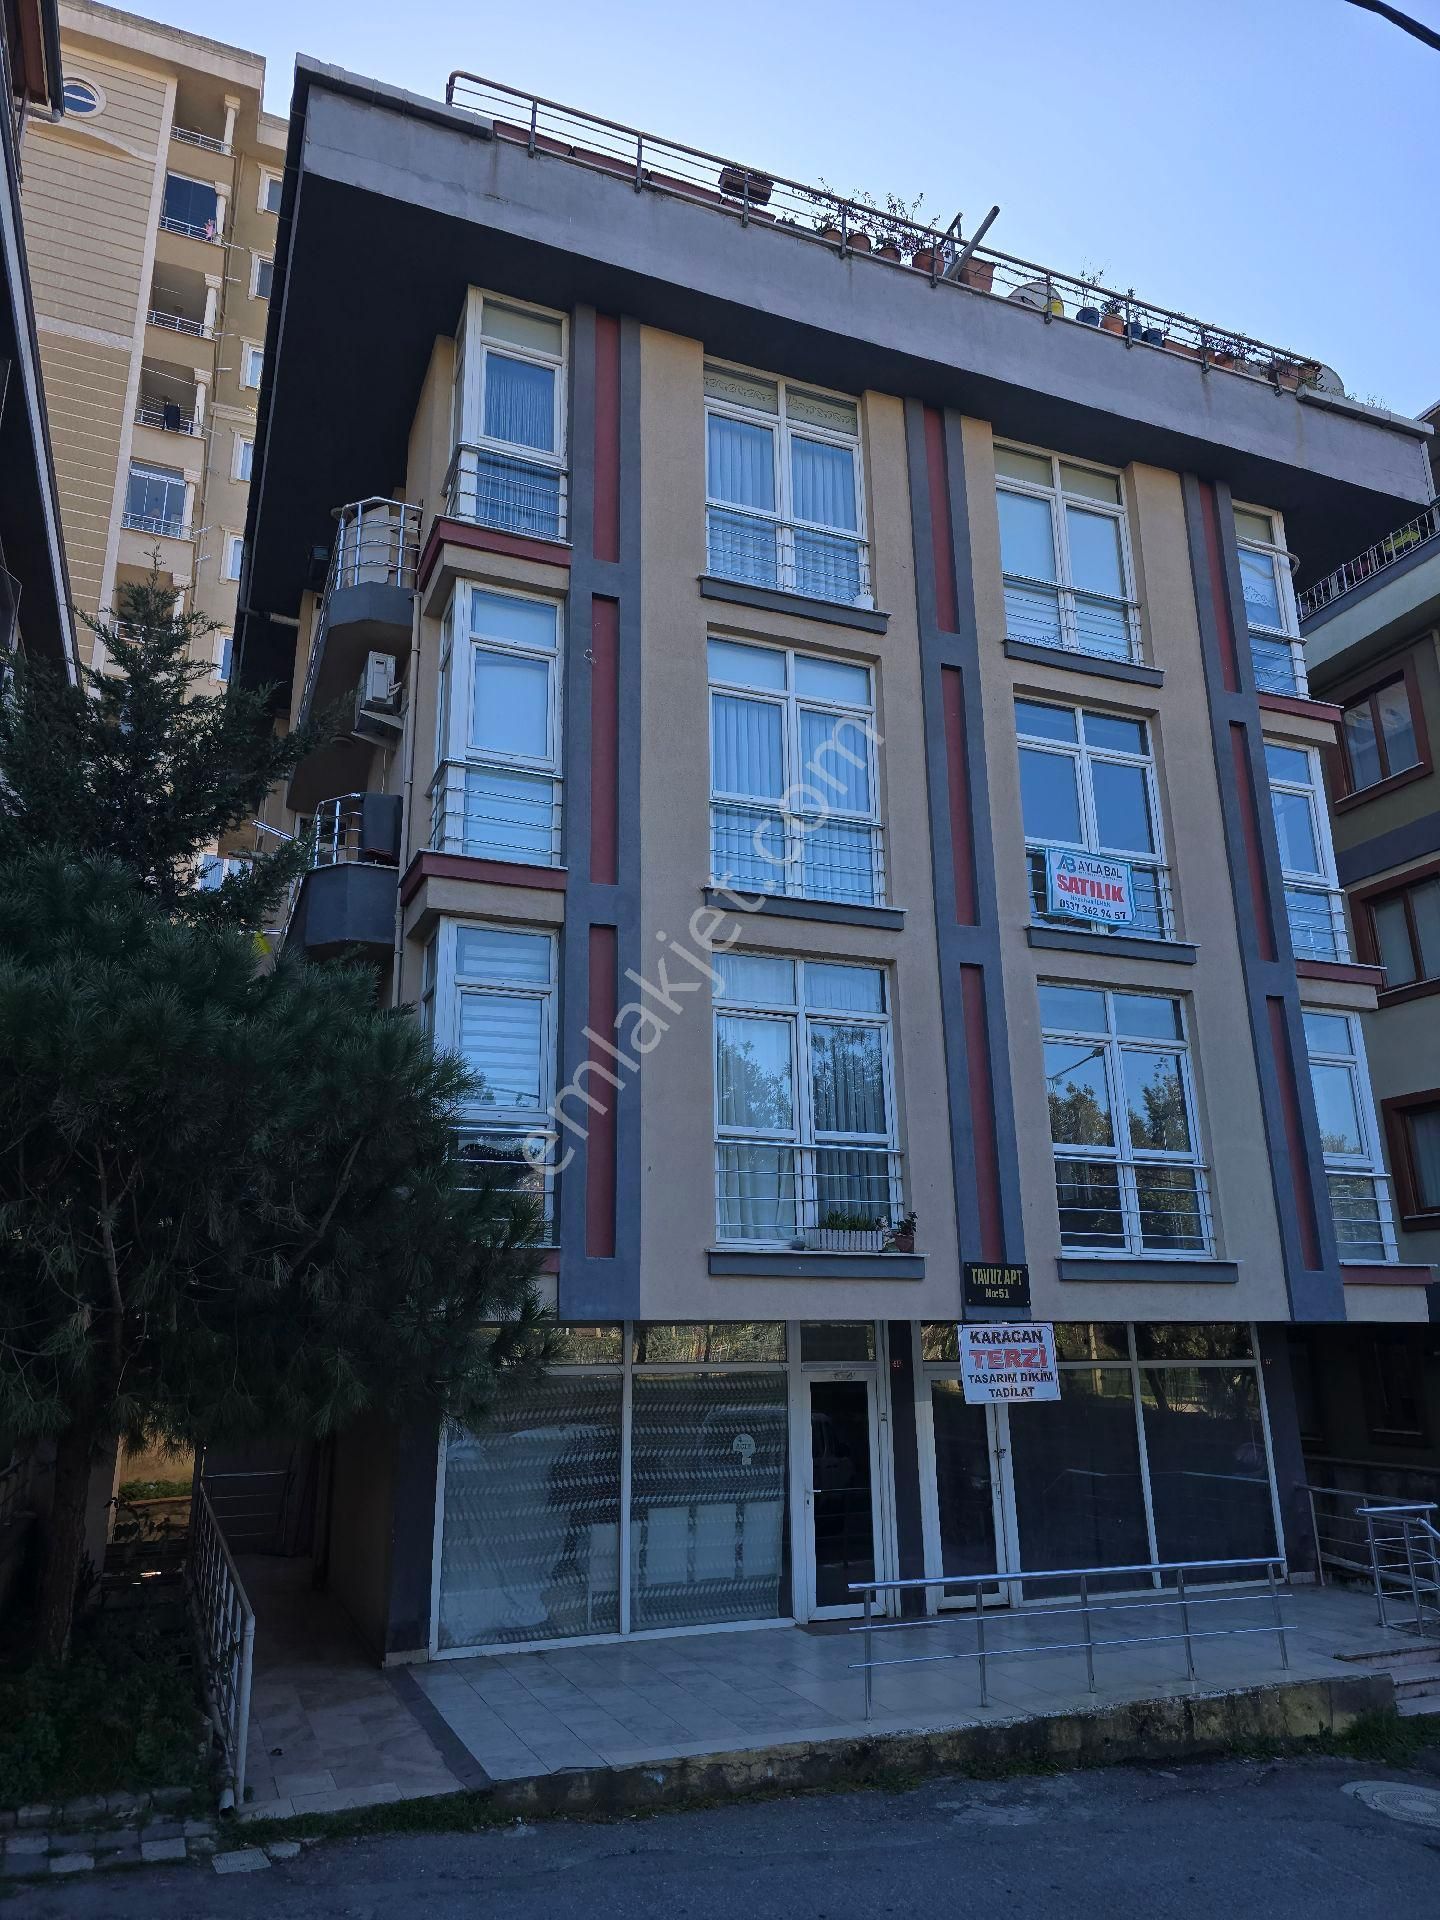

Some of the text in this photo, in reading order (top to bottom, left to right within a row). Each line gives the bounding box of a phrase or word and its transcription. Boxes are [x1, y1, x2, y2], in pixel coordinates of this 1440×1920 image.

[1056, 874, 1125, 903] SATILIK
[1060, 898, 1080, 912] 0537
[1082, 904, 1099, 917] 362
[1114, 911, 1126, 920] 57
[1003, 1269, 1023, 1286] APT
[968, 1344, 1049, 1370] TERZİ
[967, 1369, 1054, 1384] TASARIM DİKİM
[988, 1385, 1035, 1398] TADİLAT
